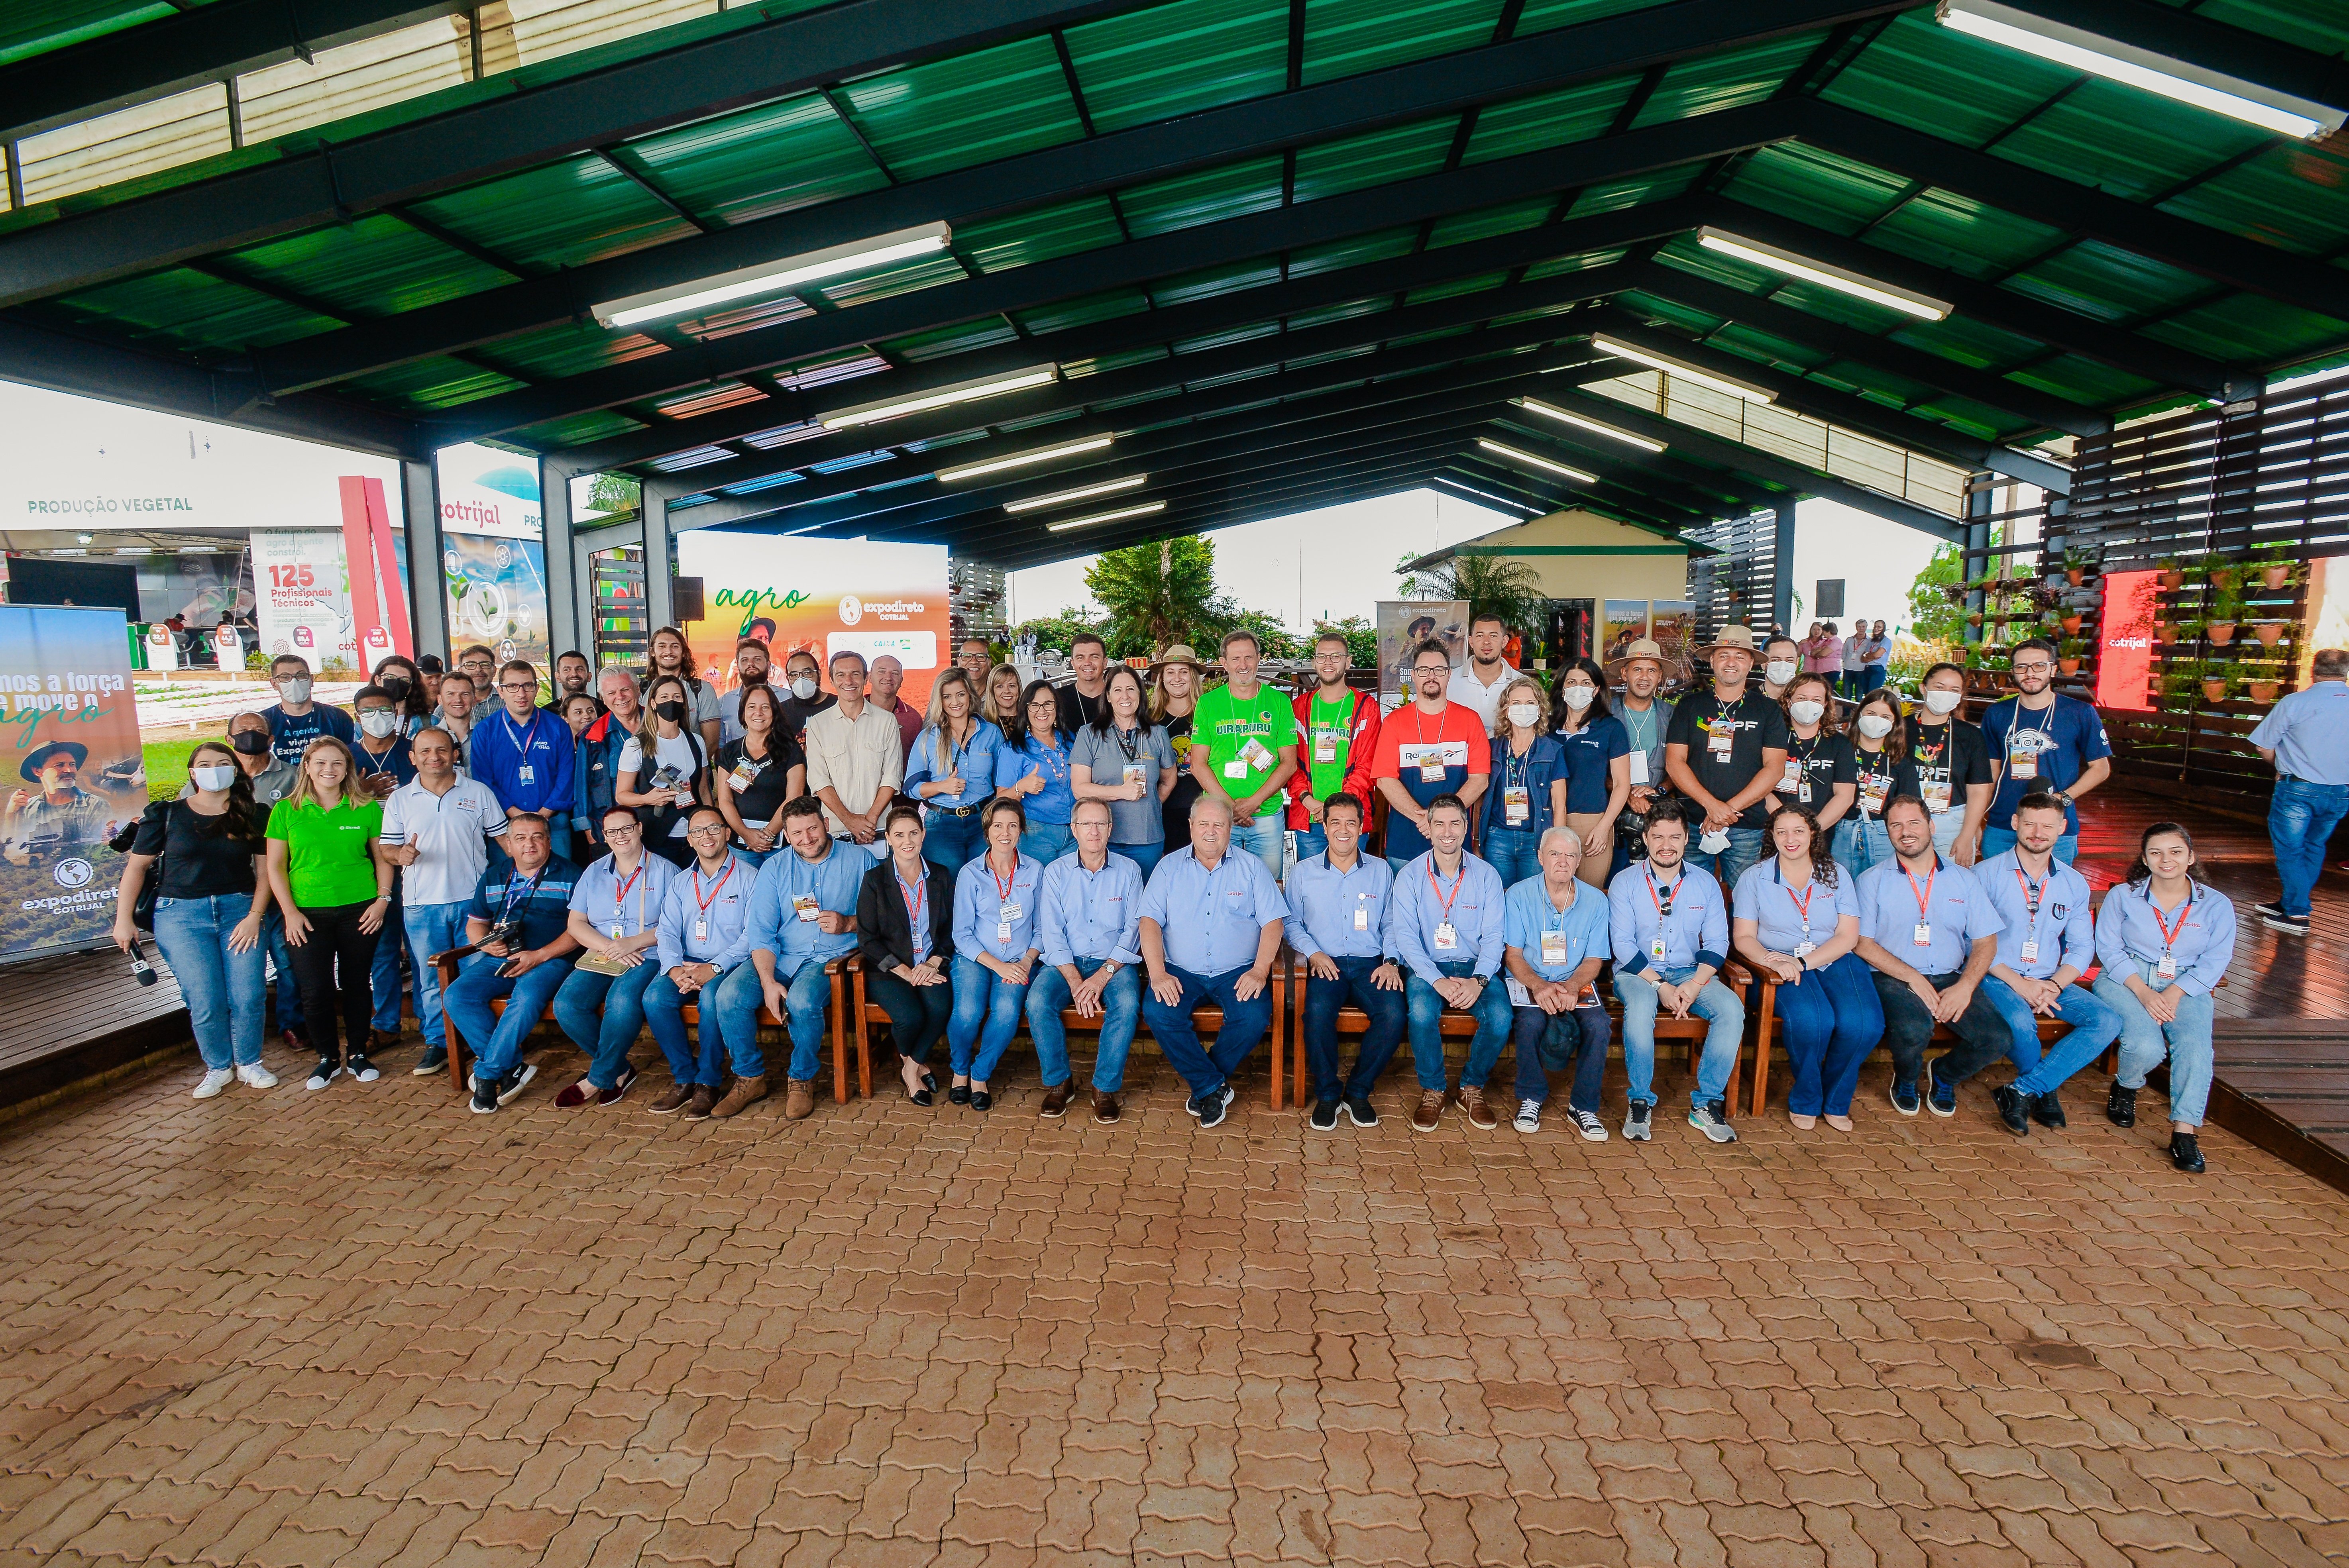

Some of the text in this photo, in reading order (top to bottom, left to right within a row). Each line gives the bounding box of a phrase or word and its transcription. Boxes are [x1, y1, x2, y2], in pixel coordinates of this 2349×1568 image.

[28, 496, 193, 517] PRODUÇÃO VEGETAL
[266, 540, 287, 548] agro
[298, 538, 324, 548] gente
[267, 548, 306, 556] constrói.
[269, 564, 315, 587] 125
[271, 587, 332, 599] Profissionais
[272, 598, 314, 607] Técnicos
[863, 600, 925, 615] expodireto
[715, 587, 811, 635] agro
[1611, 619, 1640, 631] agro
[2109, 637, 2146, 650] cotrijal
[47, 674, 62, 692] a
[67, 672, 125, 697] força
[14, 693, 79, 712] move
[293, 727, 320, 736] gente
[1216, 723, 1271, 735] UIRAPURU
[1733, 720, 1758, 731] PF
[1797, 759, 1834, 770] PF
[22, 886, 119, 910] expodiret
[53, 901, 105, 915] COTRIJAL
